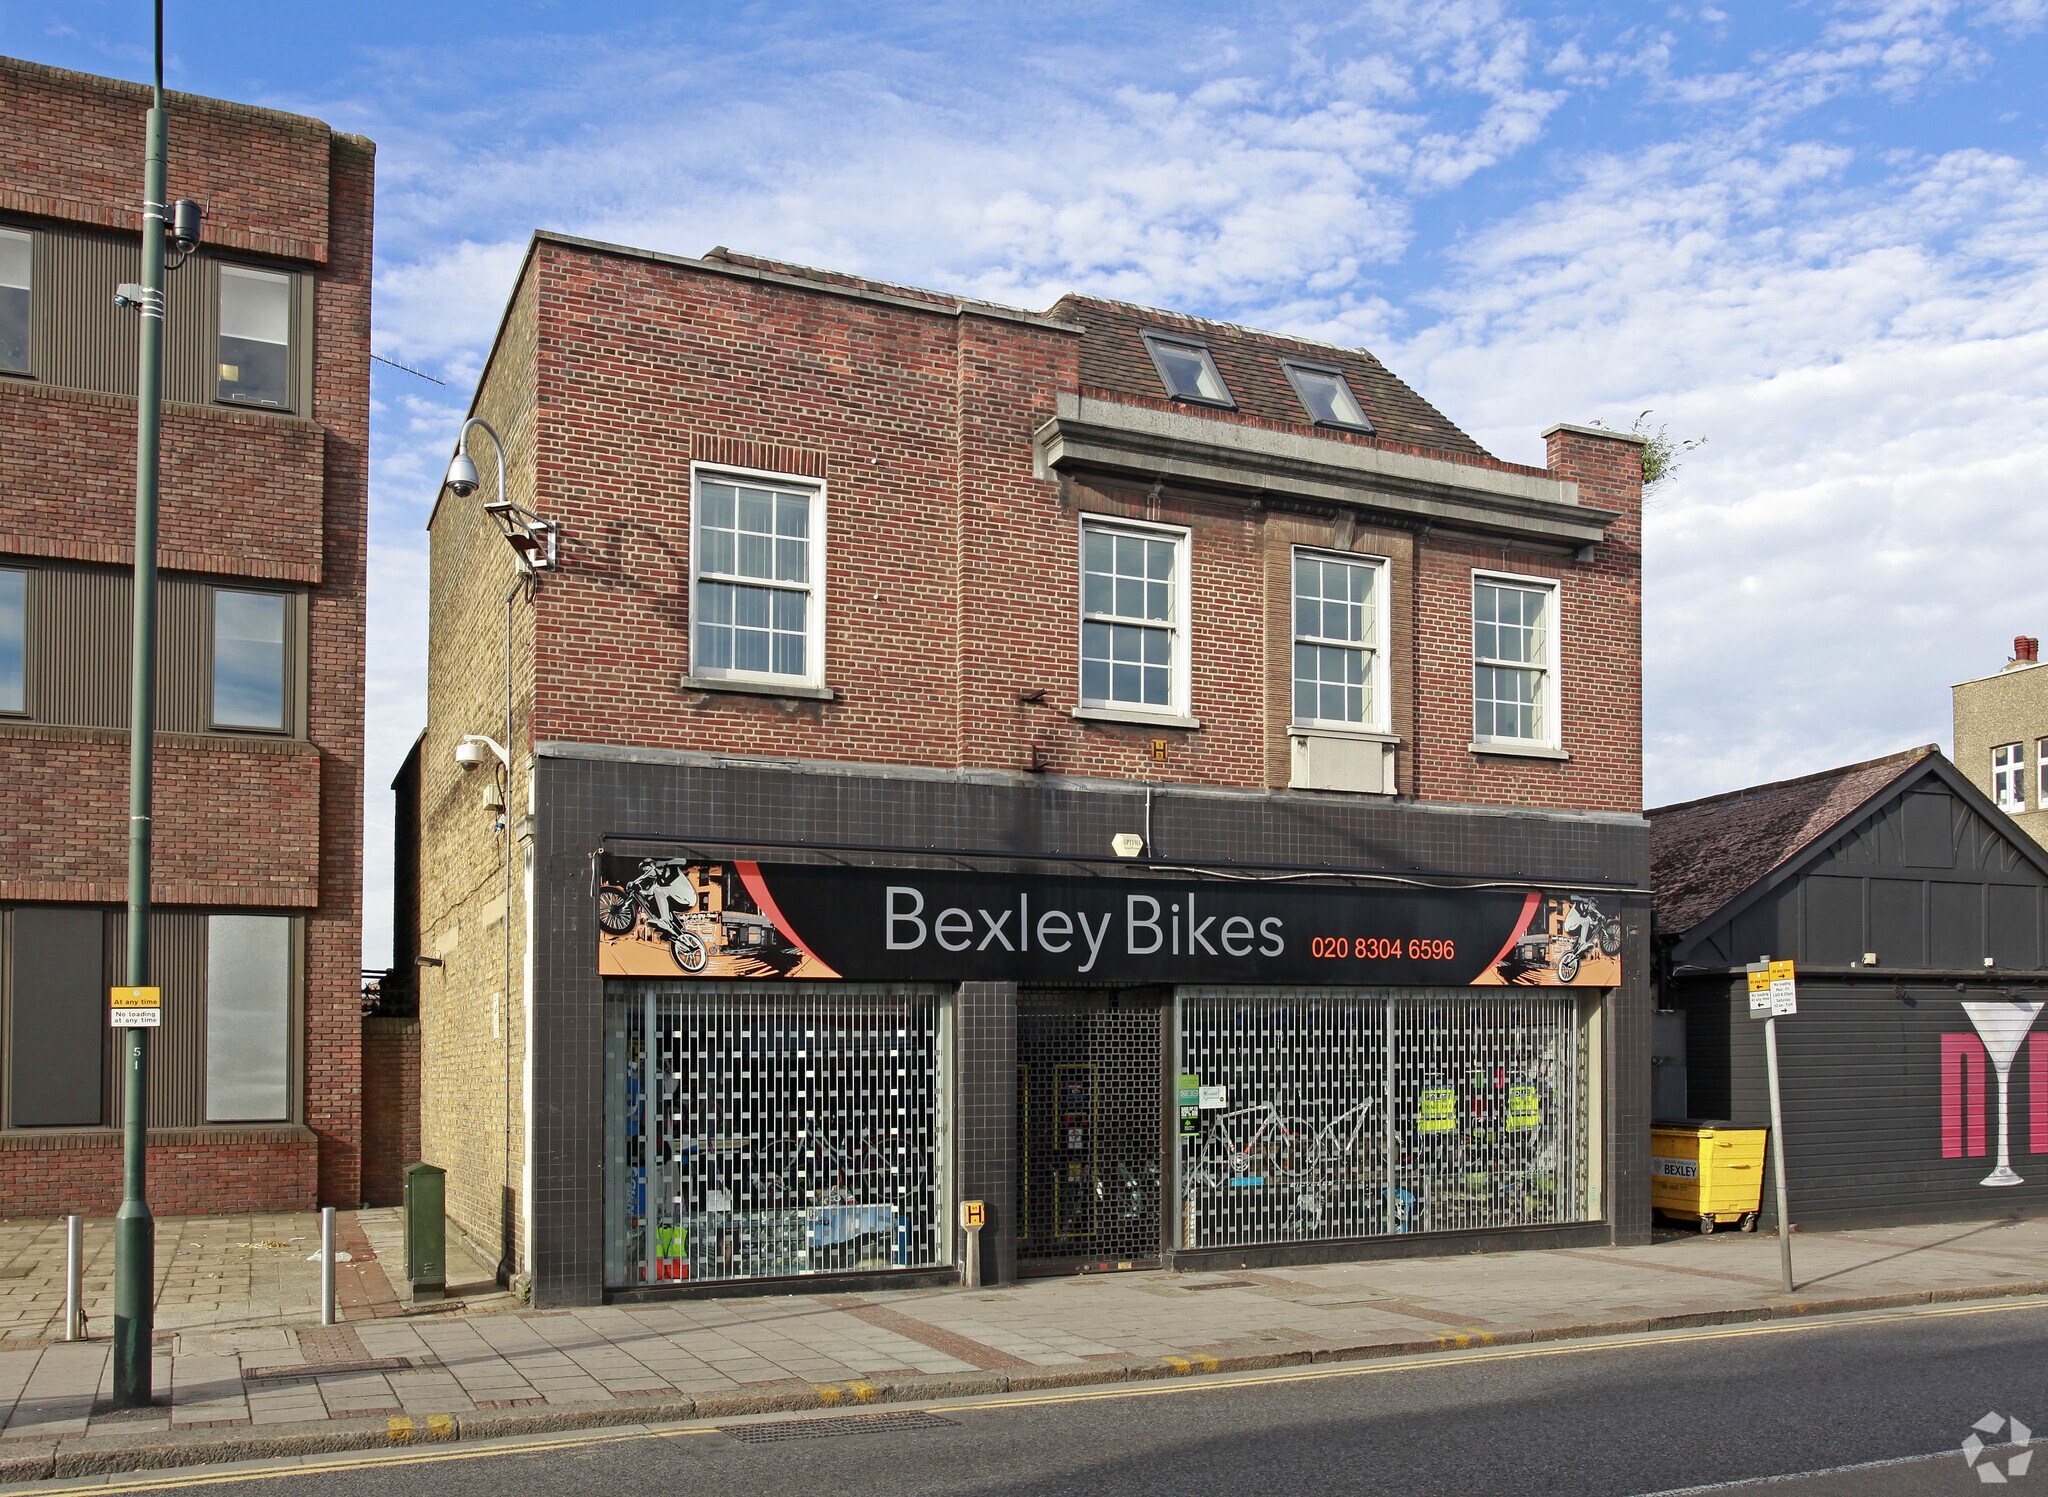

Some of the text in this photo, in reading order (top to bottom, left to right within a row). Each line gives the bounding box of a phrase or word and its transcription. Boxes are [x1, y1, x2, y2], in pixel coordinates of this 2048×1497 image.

[1153, 741, 1166, 759] H
[886, 886, 1455, 972] Bexley Bikes 020 8304 6596
[1664, 1164, 1697, 1177] BEXLEY
[968, 1204, 982, 1223] H
